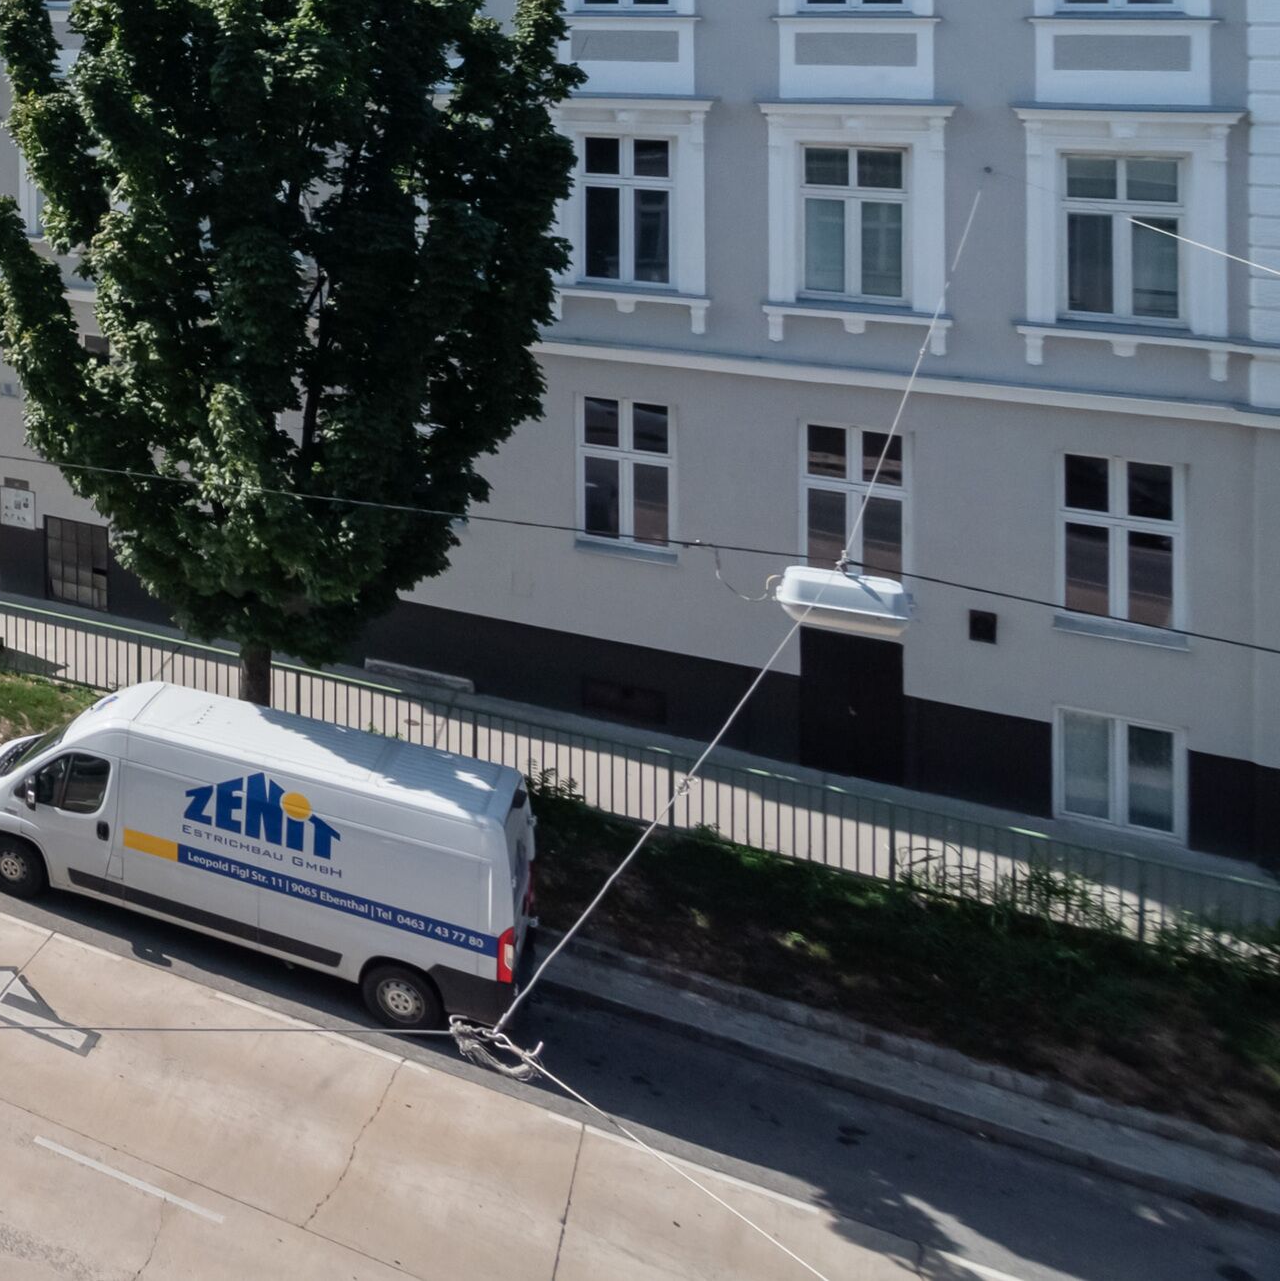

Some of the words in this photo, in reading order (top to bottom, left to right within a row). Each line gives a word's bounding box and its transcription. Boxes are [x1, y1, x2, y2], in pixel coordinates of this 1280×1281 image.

[182, 824, 284, 861] ESTRICHBAU
[187, 852, 229, 872] Leopold
[230, 864, 250, 879] Figl
[251, 870, 269, 884] Str.
[271, 876, 283, 887] 11
[290, 883, 318, 898] 9065
[319, 890, 368, 914] Ebenthal
[375, 907, 392, 921] Tel
[396, 914, 425, 931] 0463
[434, 926, 449, 938] 43
[452, 930, 466, 943] 77
[468, 935, 484, 948] 80
